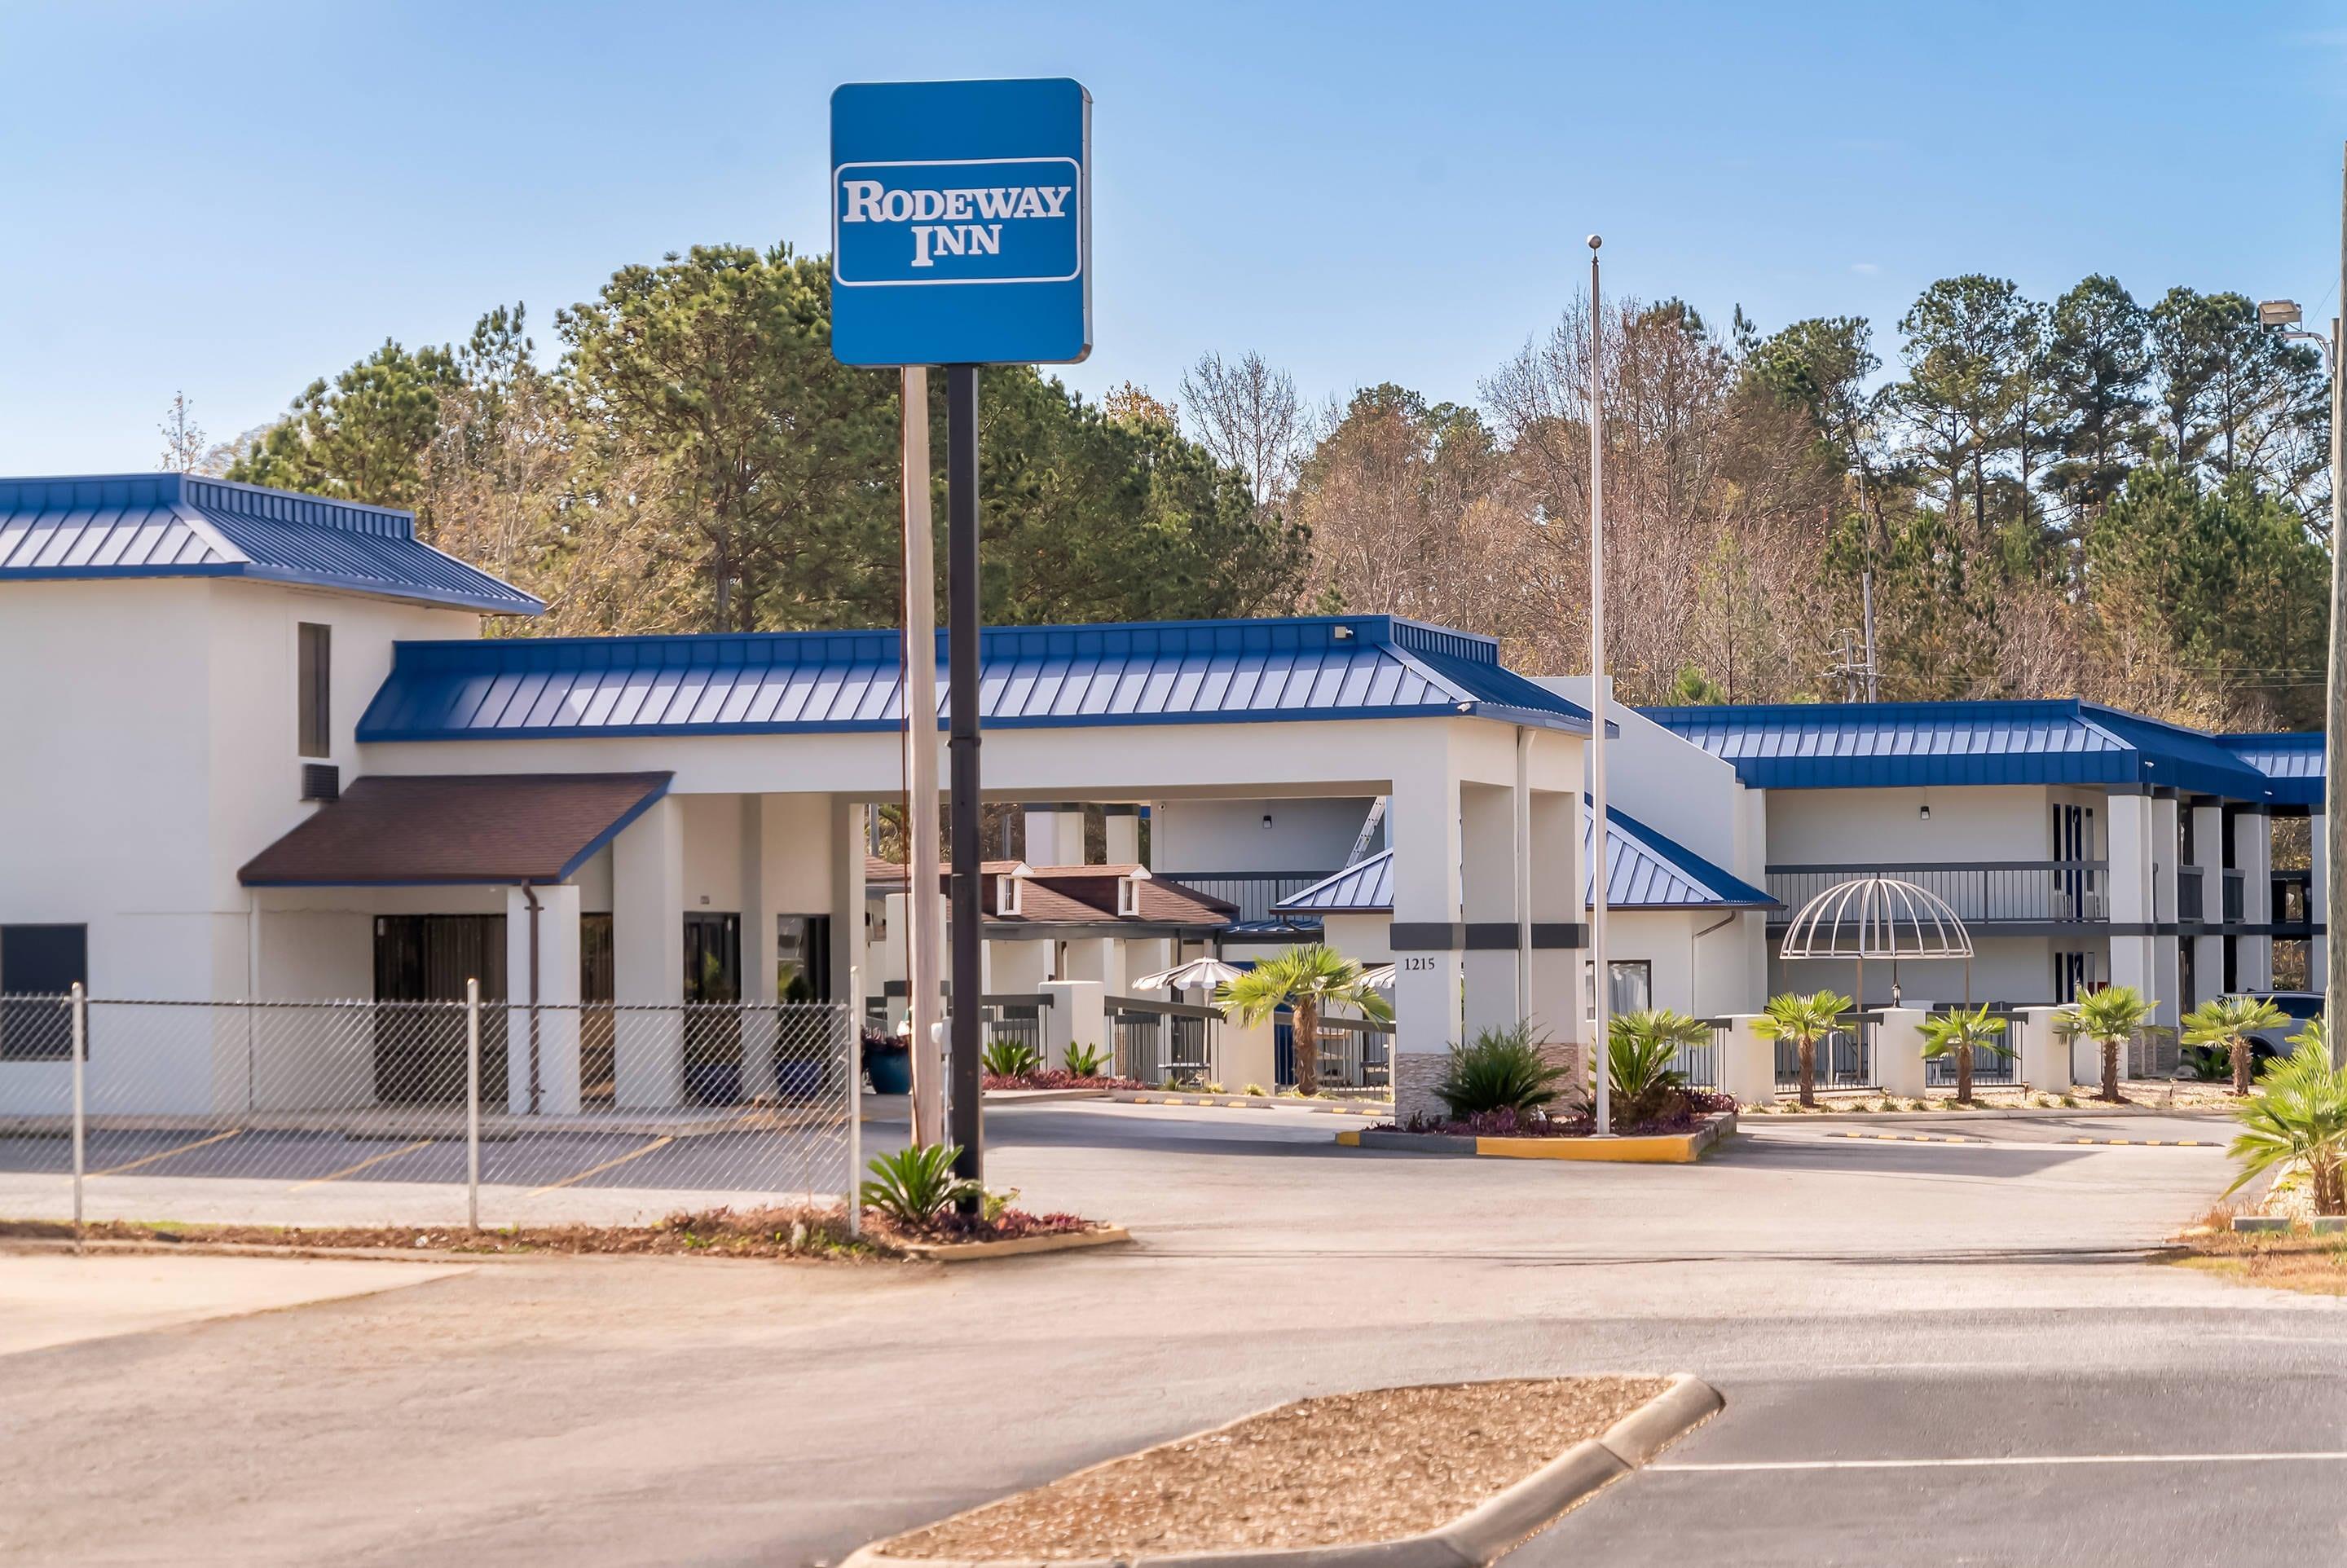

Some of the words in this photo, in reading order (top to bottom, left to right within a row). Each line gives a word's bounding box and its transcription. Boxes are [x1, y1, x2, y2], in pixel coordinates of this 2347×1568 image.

[843, 180, 1071, 222] RODEWAY
[911, 224, 1002, 266] INN
[1404, 958, 1435, 970] 1215
